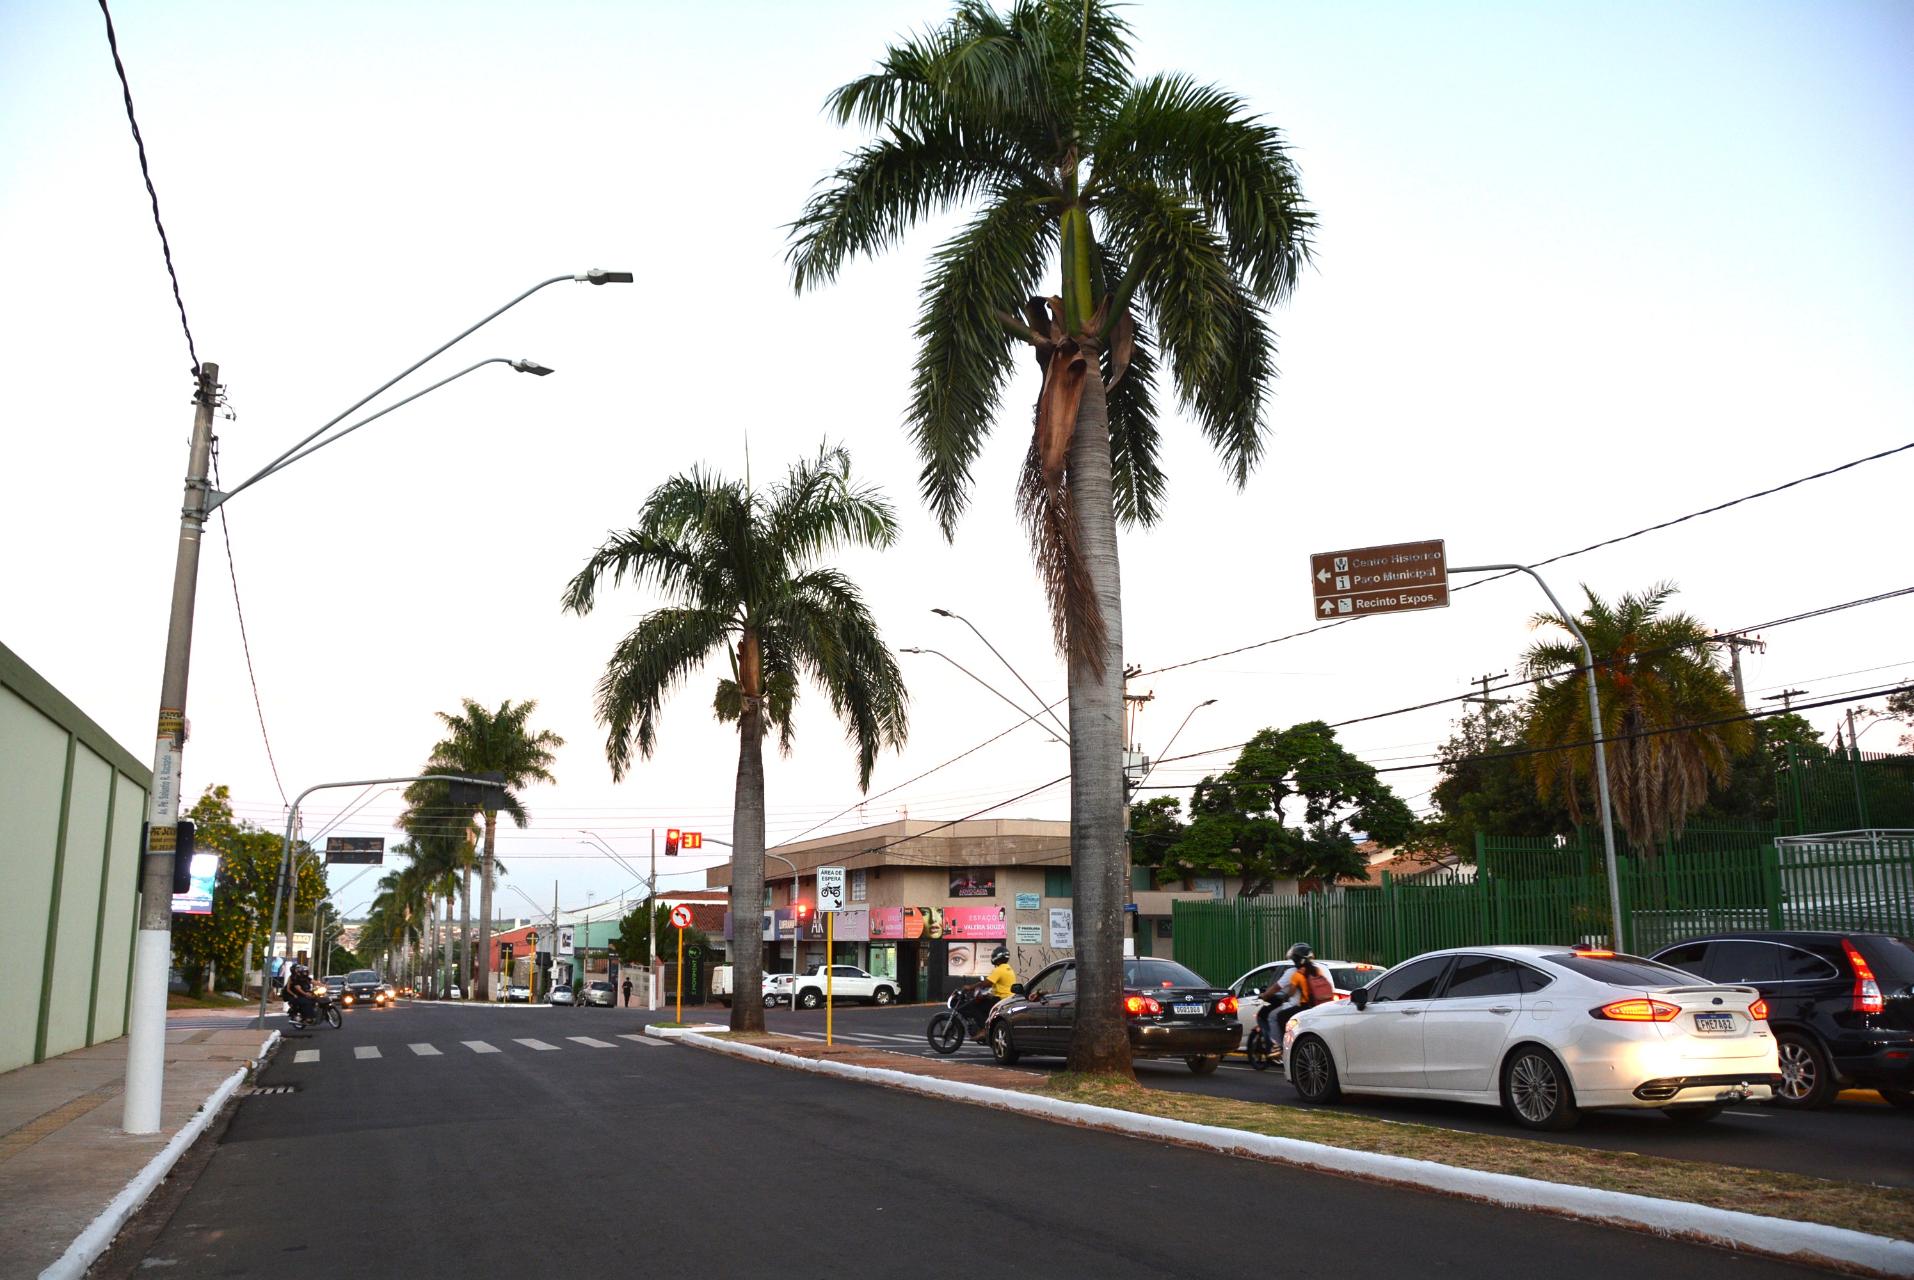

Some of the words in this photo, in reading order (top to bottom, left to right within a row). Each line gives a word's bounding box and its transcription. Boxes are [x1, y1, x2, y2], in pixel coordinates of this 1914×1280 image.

[1353, 557, 1388, 568] Centro
[1383, 566, 1436, 581] Municipal
[1356, 597, 1397, 608] Recinto
[1399, 593, 1438, 605] Expos.
[685, 834, 699, 847] 31
